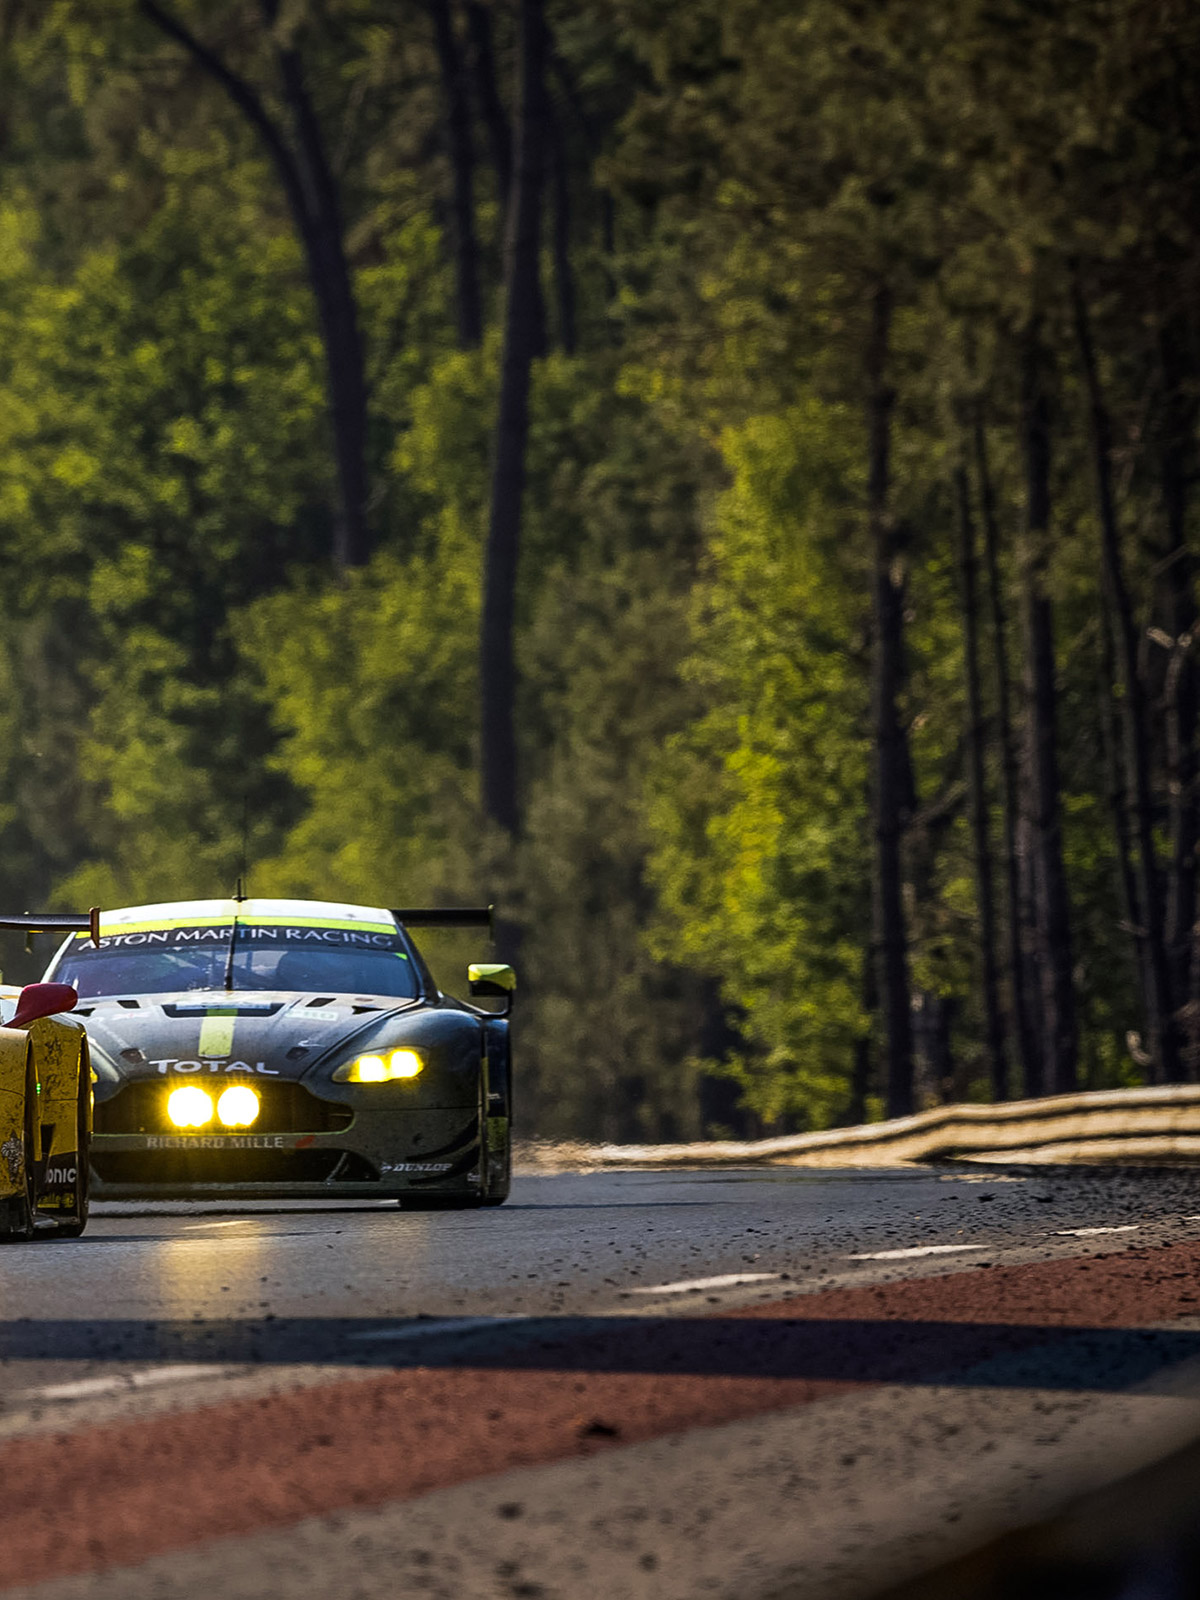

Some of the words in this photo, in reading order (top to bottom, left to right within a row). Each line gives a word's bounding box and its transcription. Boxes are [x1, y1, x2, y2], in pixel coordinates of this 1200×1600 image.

[77, 932, 169, 952] ASTON
[175, 928, 277, 941] MARTIN
[285, 928, 393, 946] RACING
[149, 1058, 280, 1075] TOTAL
[146, 1136, 225, 1149] RICHARD
[230, 1136, 284, 1149] MILLE
[392, 1163, 453, 1172] DUNLOP
